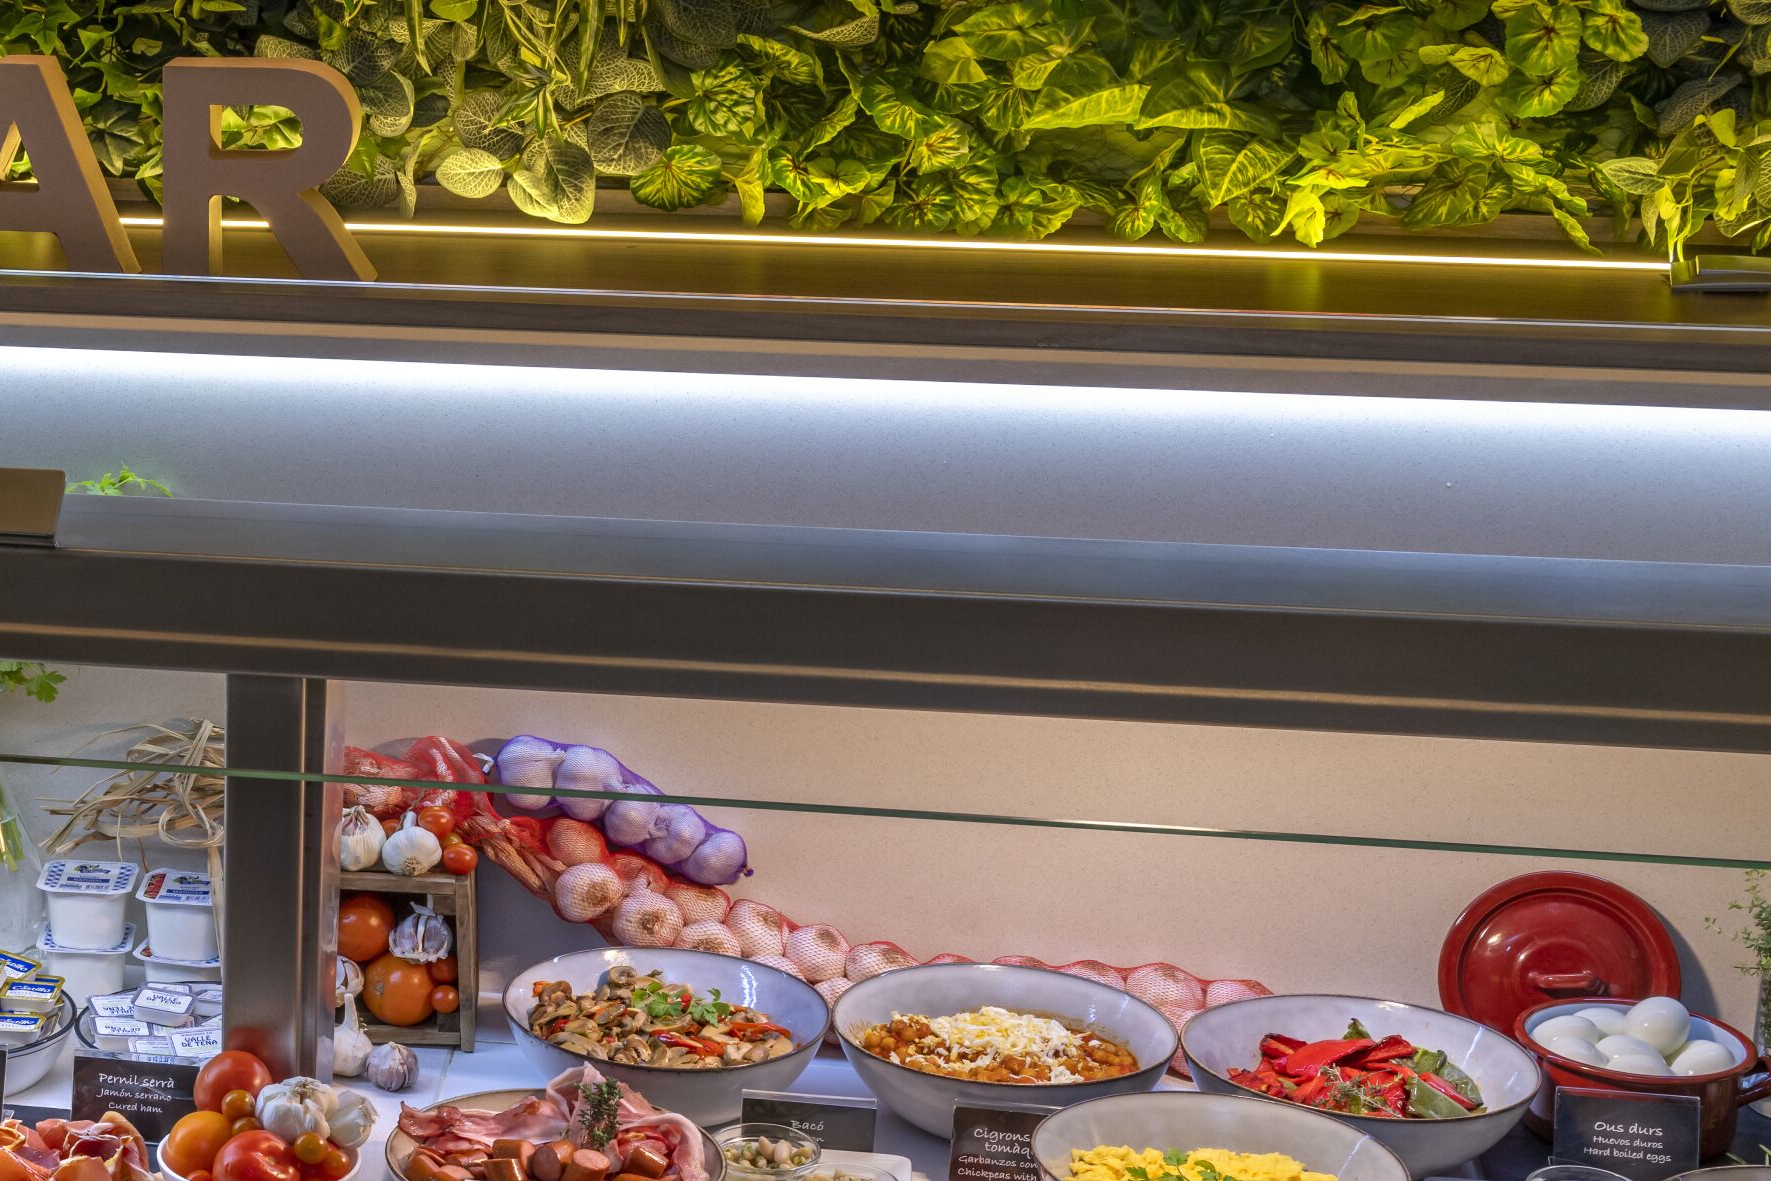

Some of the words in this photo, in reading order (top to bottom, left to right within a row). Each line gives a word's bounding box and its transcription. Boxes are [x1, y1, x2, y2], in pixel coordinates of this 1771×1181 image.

[98, 1073, 138, 1085] Pernil
[139, 1077, 174, 1089] serrà
[95, 1088, 133, 1098] Jamón
[134, 1092, 172, 1102] serrano
[108, 1101, 138, 1111] Cured
[140, 1103, 163, 1113] ham
[790, 1120, 824, 1131] Bacó
[1594, 1121, 1625, 1132] Ous
[1628, 1122, 1663, 1136] durs
[973, 1128, 1031, 1143] Cigrons
[1593, 1135, 1630, 1146] Huevos
[1633, 1138, 1664, 1149] duros
[958, 1155, 1017, 1167] Garbanzos
[1019, 1161, 1037, 1169] con
[1583, 1147, 1610, 1156] Hard
[1613, 1148, 1644, 1159] boiled
[1646, 1153, 1672, 1164] eggs
[957, 1167, 1011, 1181] Chickpeas
[1013, 1173, 1037, 1181] with
